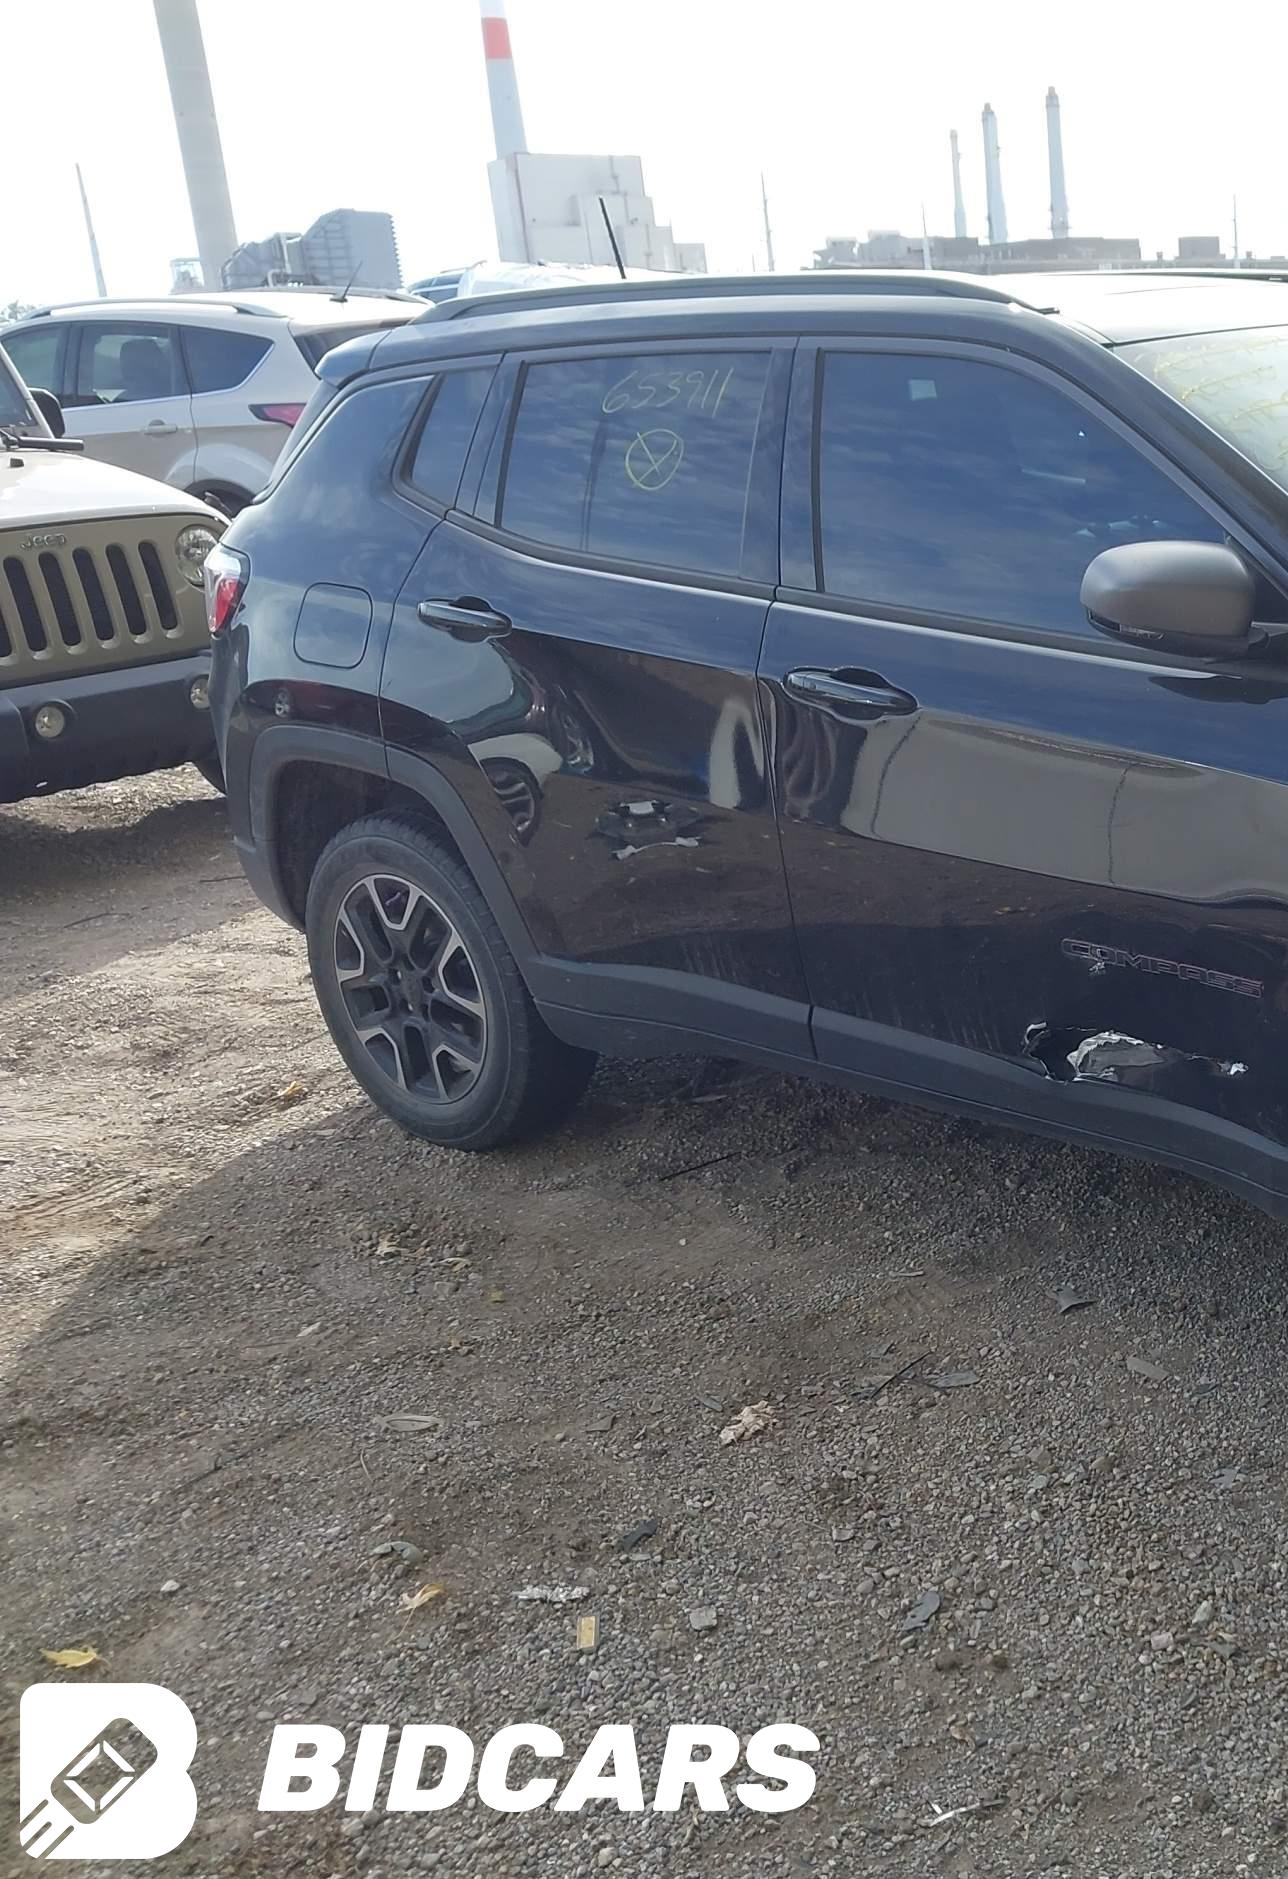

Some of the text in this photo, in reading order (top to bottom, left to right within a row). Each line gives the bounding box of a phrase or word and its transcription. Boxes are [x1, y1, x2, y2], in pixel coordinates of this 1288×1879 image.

[602, 368, 735, 419] 653911
[20, 533, 66, 549] Jeep
[1061, 938, 1265, 999] COMPASS
